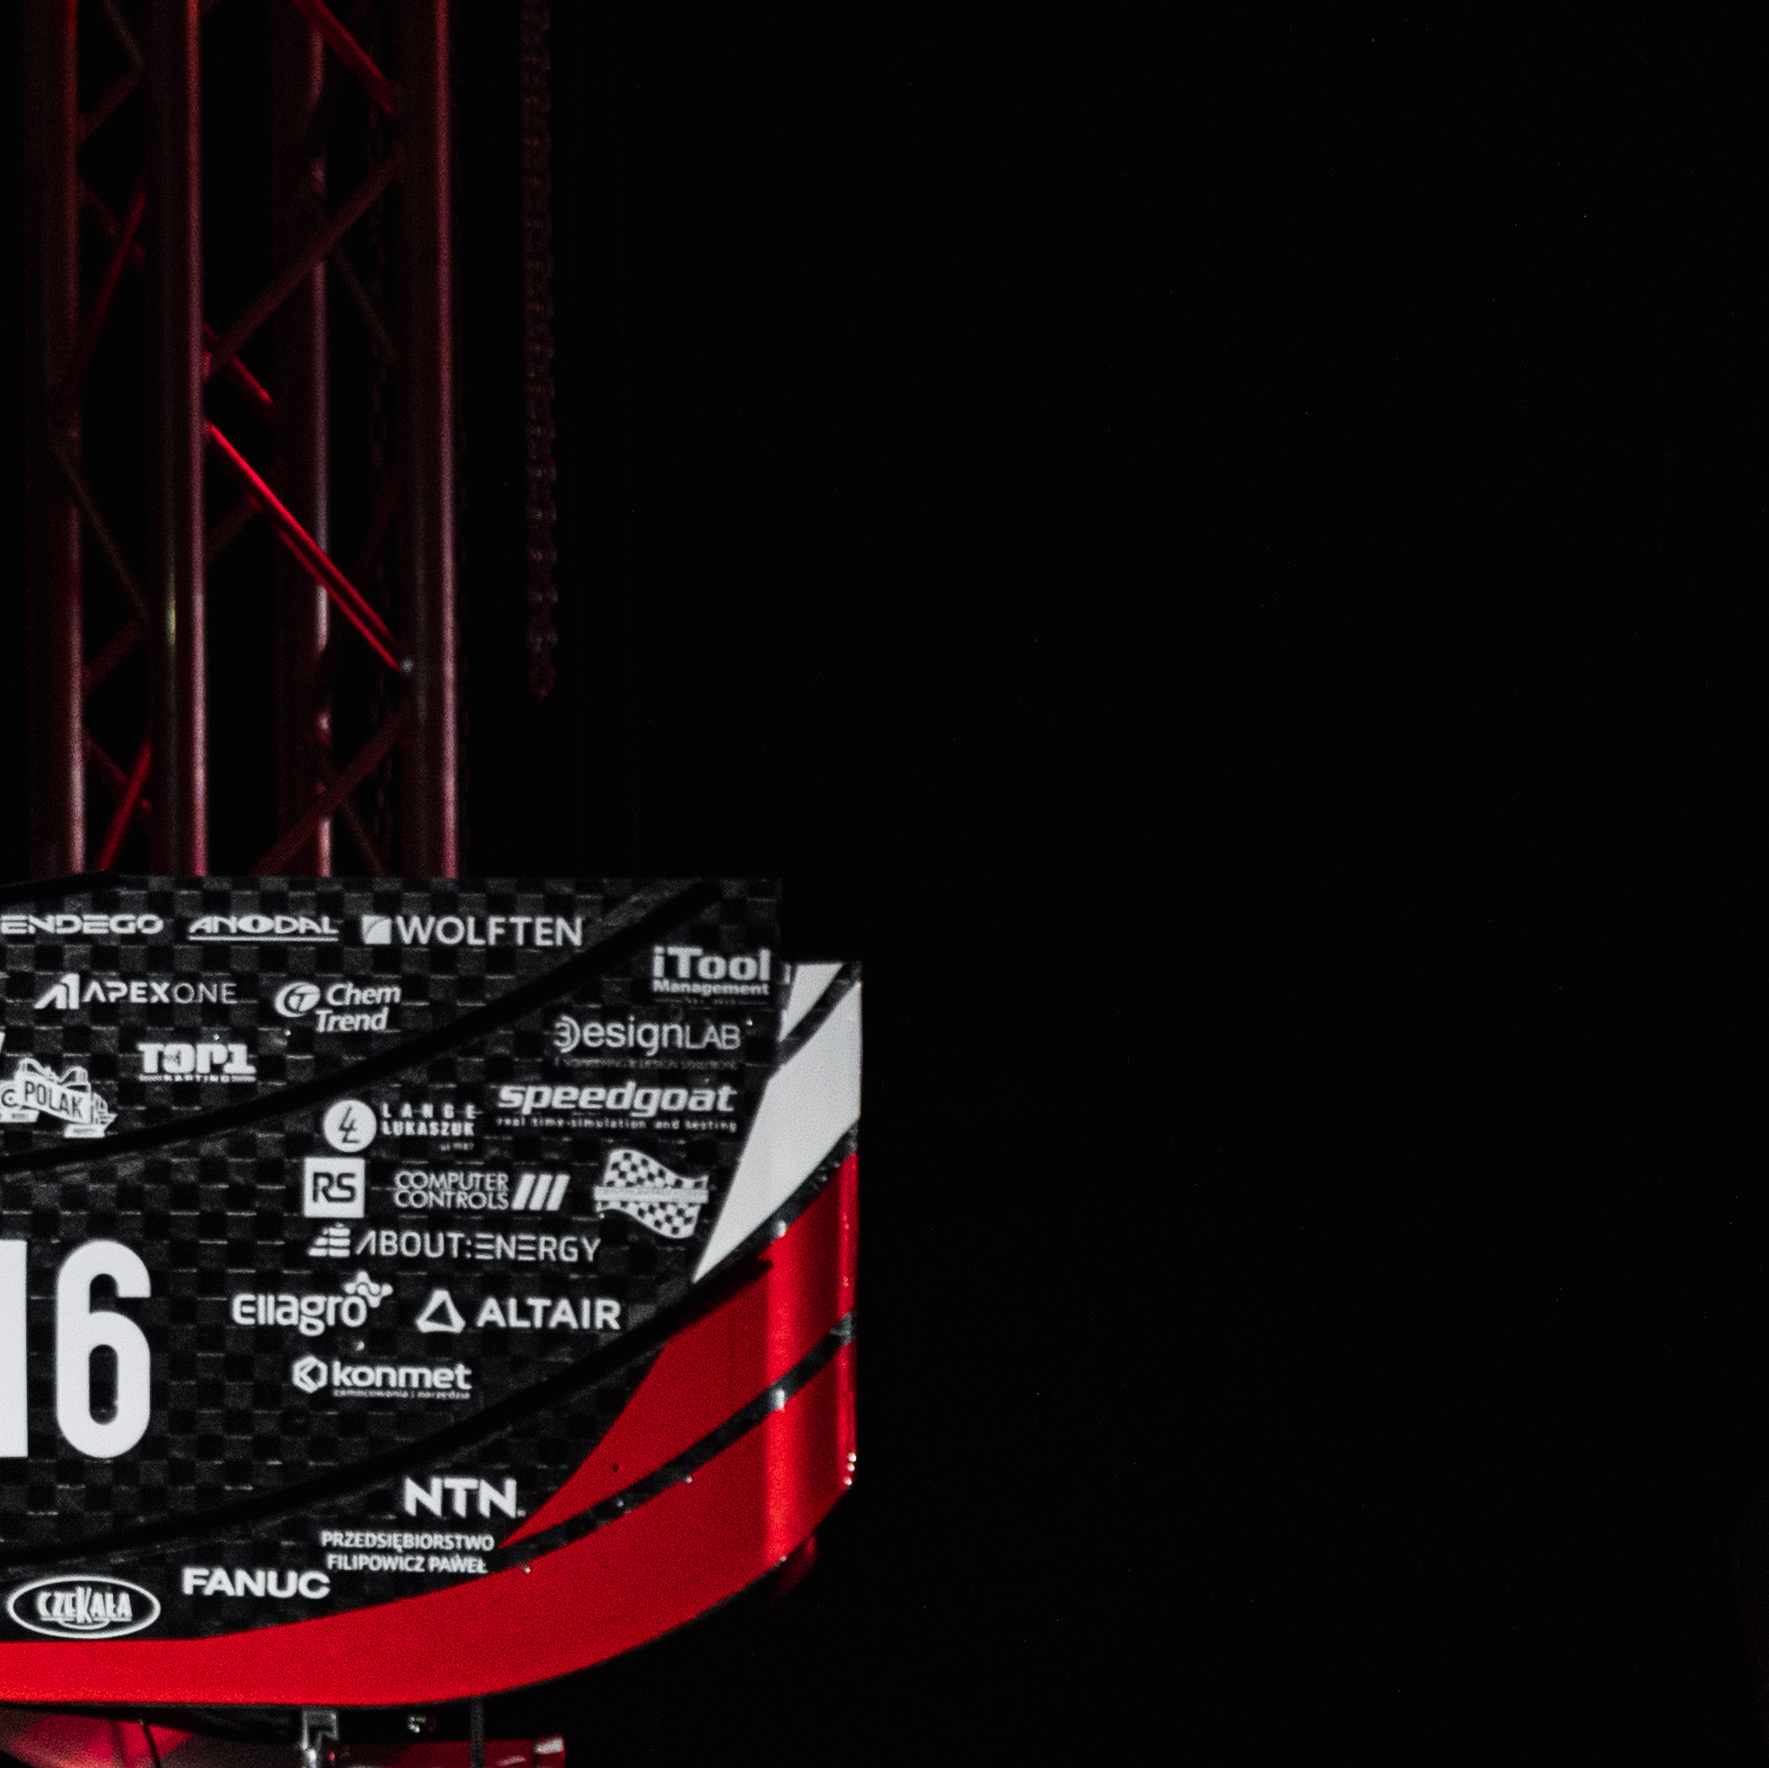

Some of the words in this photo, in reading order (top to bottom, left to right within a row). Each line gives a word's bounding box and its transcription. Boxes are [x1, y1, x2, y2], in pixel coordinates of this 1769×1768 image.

[0, 914, 165, 935] ENDEGO
[188, 915, 340, 936] ANODAL
[396, 915, 583, 947] WOLFTEN
[652, 945, 772, 982] iTool
[325, 982, 401, 1006] Chem
[651, 979, 770, 997] Management
[315, 1008, 388, 1033] Trend
[23, 1081, 85, 1119] POLAK
[496, 1078, 738, 1118] speedgoat
[312, 1171, 357, 1204] RS
[393, 1171, 510, 1191] COMPUTER
[393, 1190, 510, 1211] CONTROLS
[475, 1297, 622, 1331] ALTAIR
[331, 1359, 473, 1392] konmet
[403, 1476, 518, 1519] NTN
[325, 1551, 426, 1572] FILIPOWICZ
[427, 1554, 489, 1574] PAWEŁ
[182, 1567, 331, 1600] FANUC
